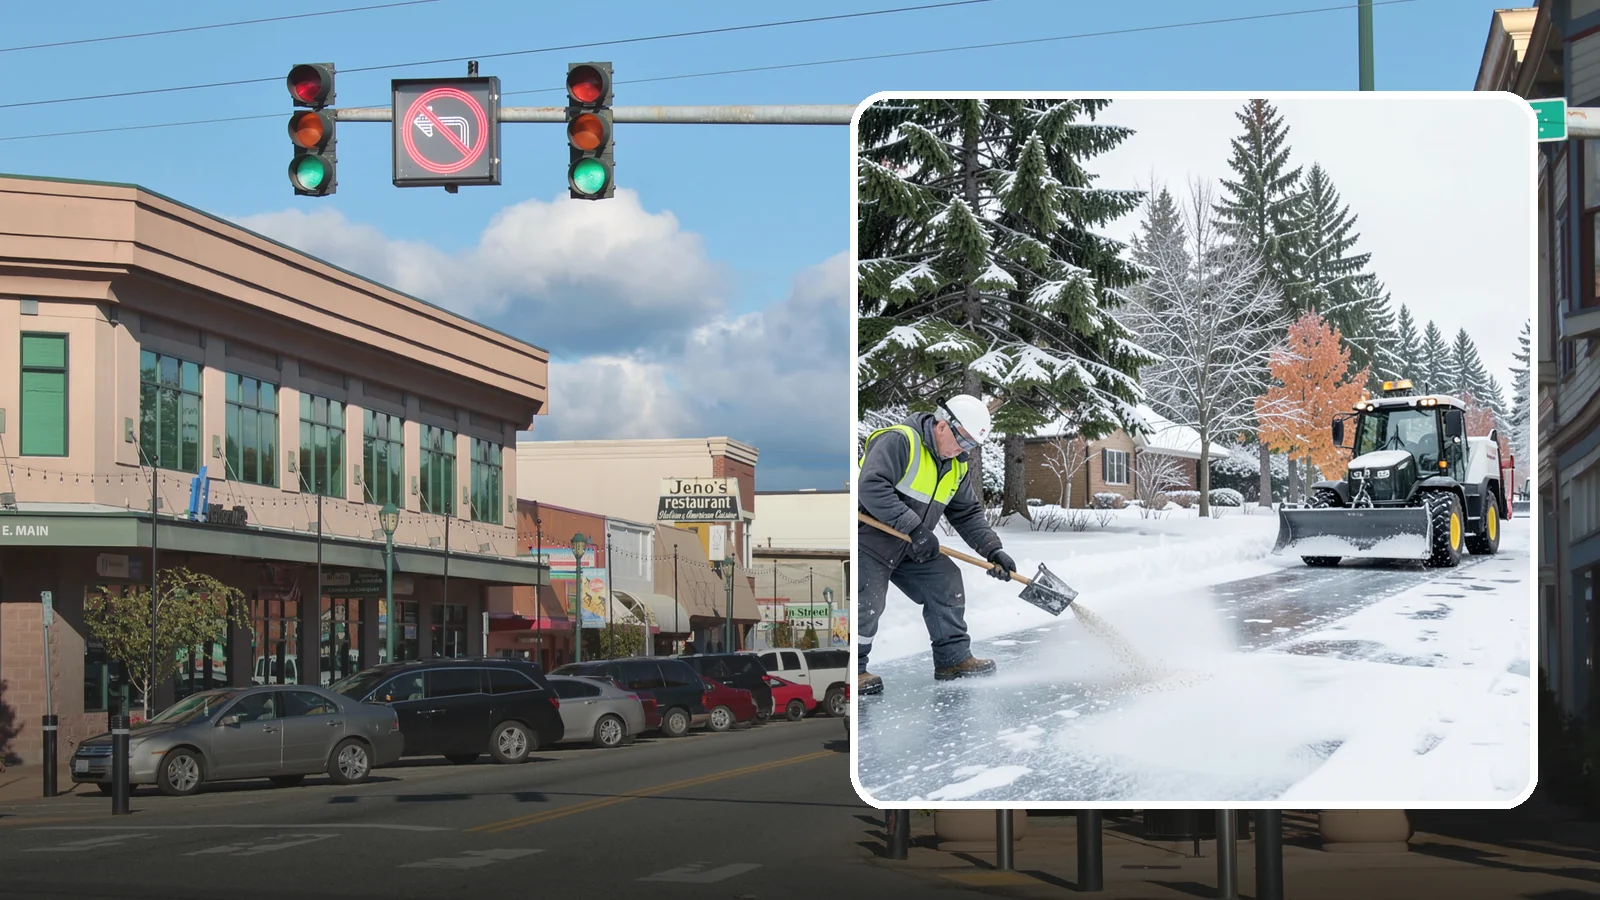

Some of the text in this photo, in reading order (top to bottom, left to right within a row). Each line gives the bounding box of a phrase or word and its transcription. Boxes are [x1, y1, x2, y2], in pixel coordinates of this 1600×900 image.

[669, 479, 727, 494] Jeno's
[665, 496, 731, 509] restaurant
[658, 509, 681, 519] Italian
[686, 509, 714, 519] American
[715, 509, 738, 519] Cuisine
[2, 525, 49, 536] E. MAIN
[797, 607, 829, 617] Street
